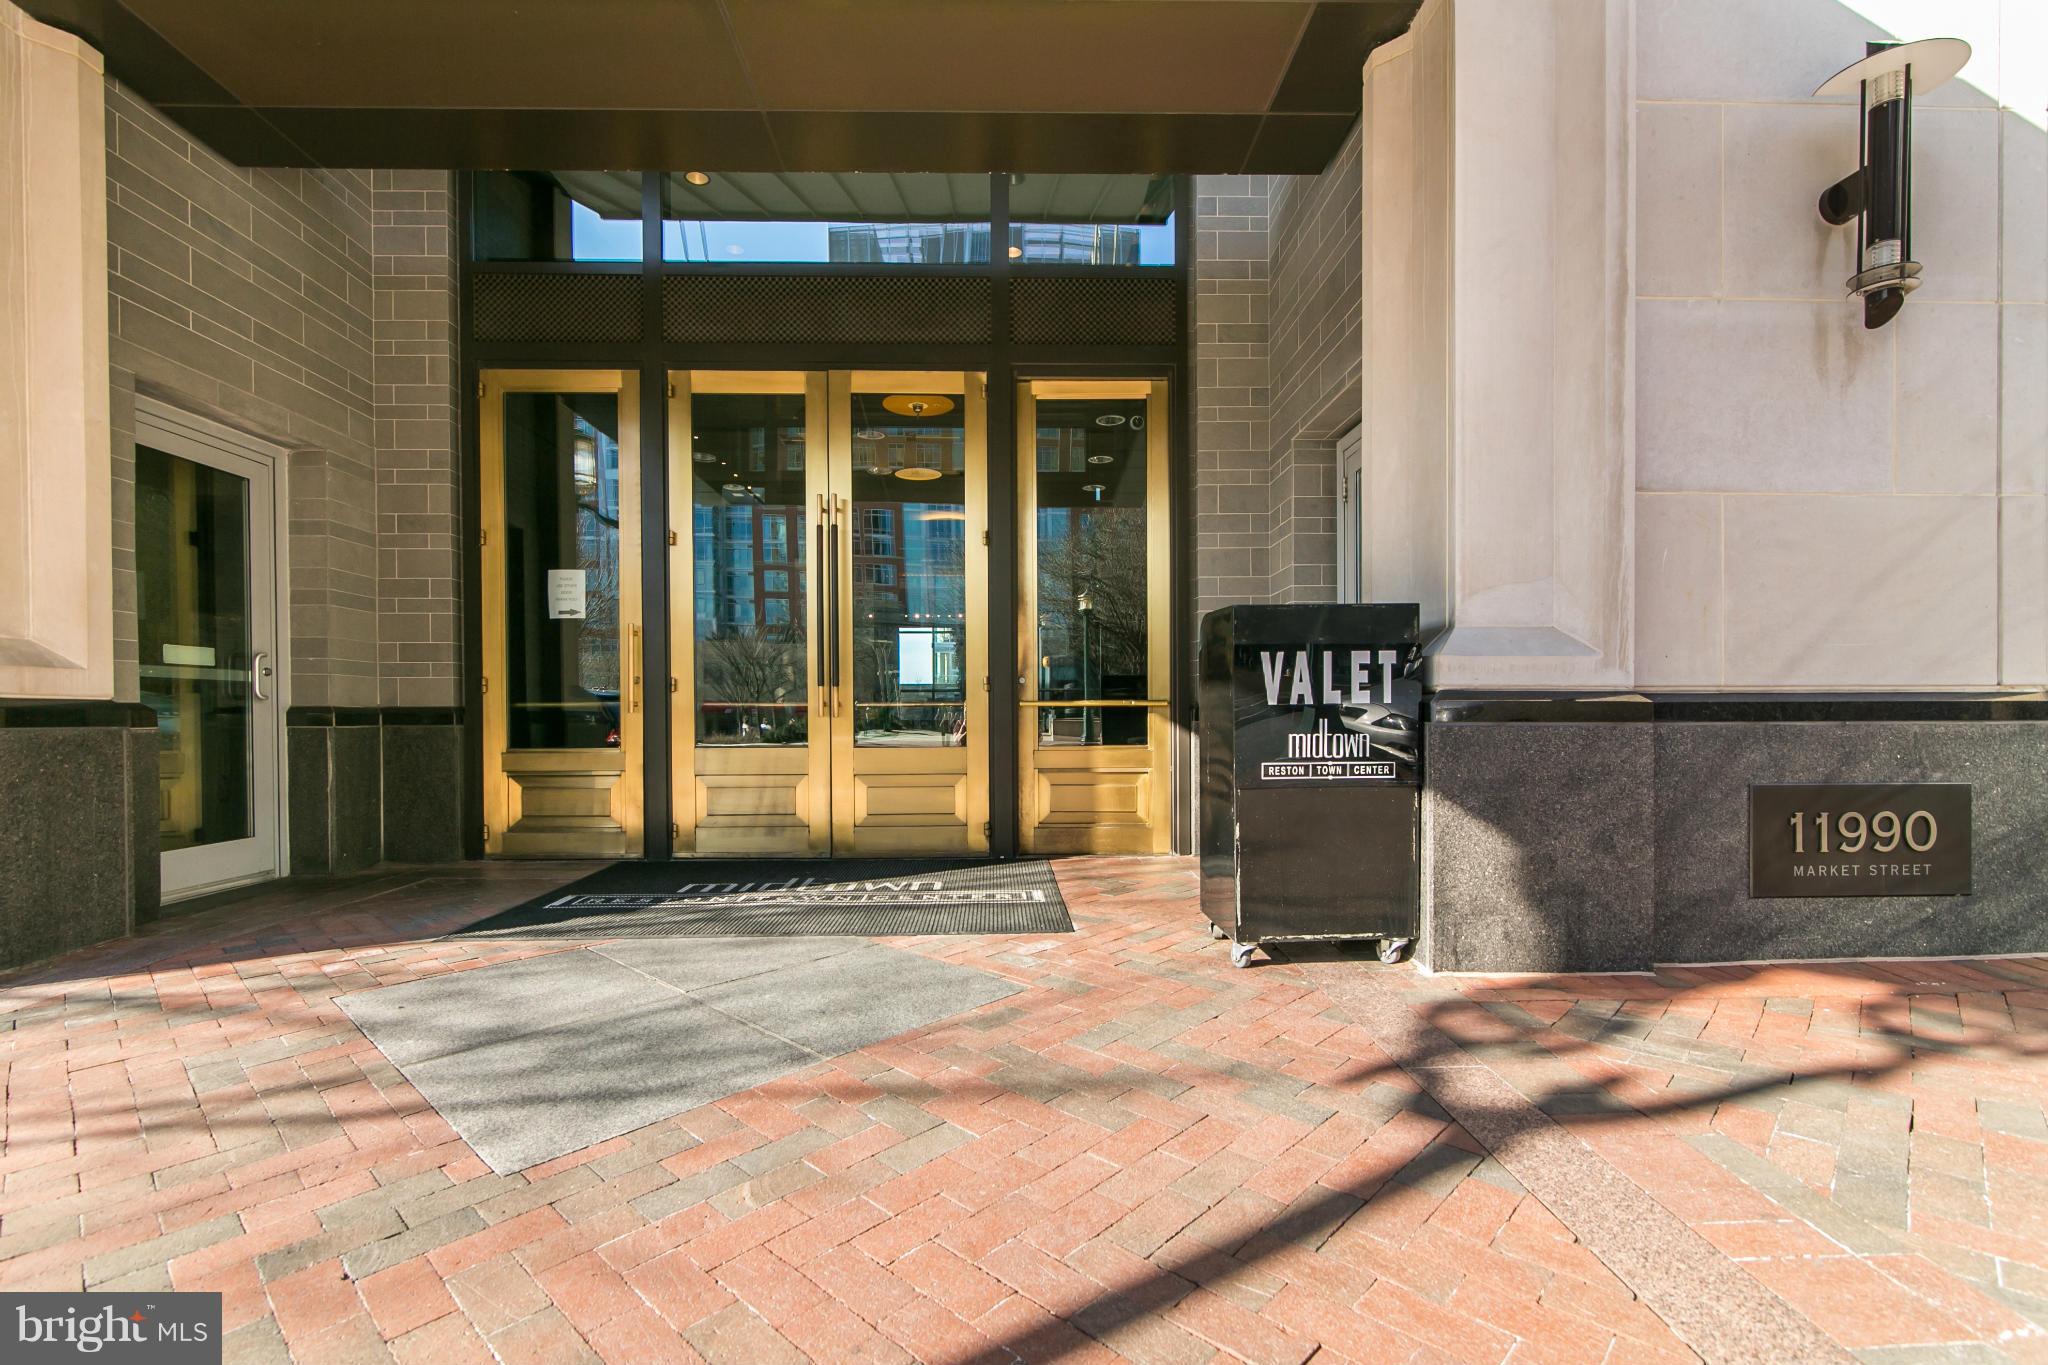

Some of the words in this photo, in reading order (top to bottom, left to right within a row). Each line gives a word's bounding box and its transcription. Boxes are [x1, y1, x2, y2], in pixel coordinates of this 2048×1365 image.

[1260, 650, 1397, 705] VALET
[1288, 718, 1370, 759] midtown
[1268, 766, 1305, 776] RESTON
[1316, 765, 1342, 775] TOWN
[1353, 764, 1390, 775] CENTER
[1790, 810, 1938, 853] 11990
[1793, 864, 1860, 877] MARKET
[1869, 863, 1932, 876] STREET
[676, 877, 943, 893] midtown
